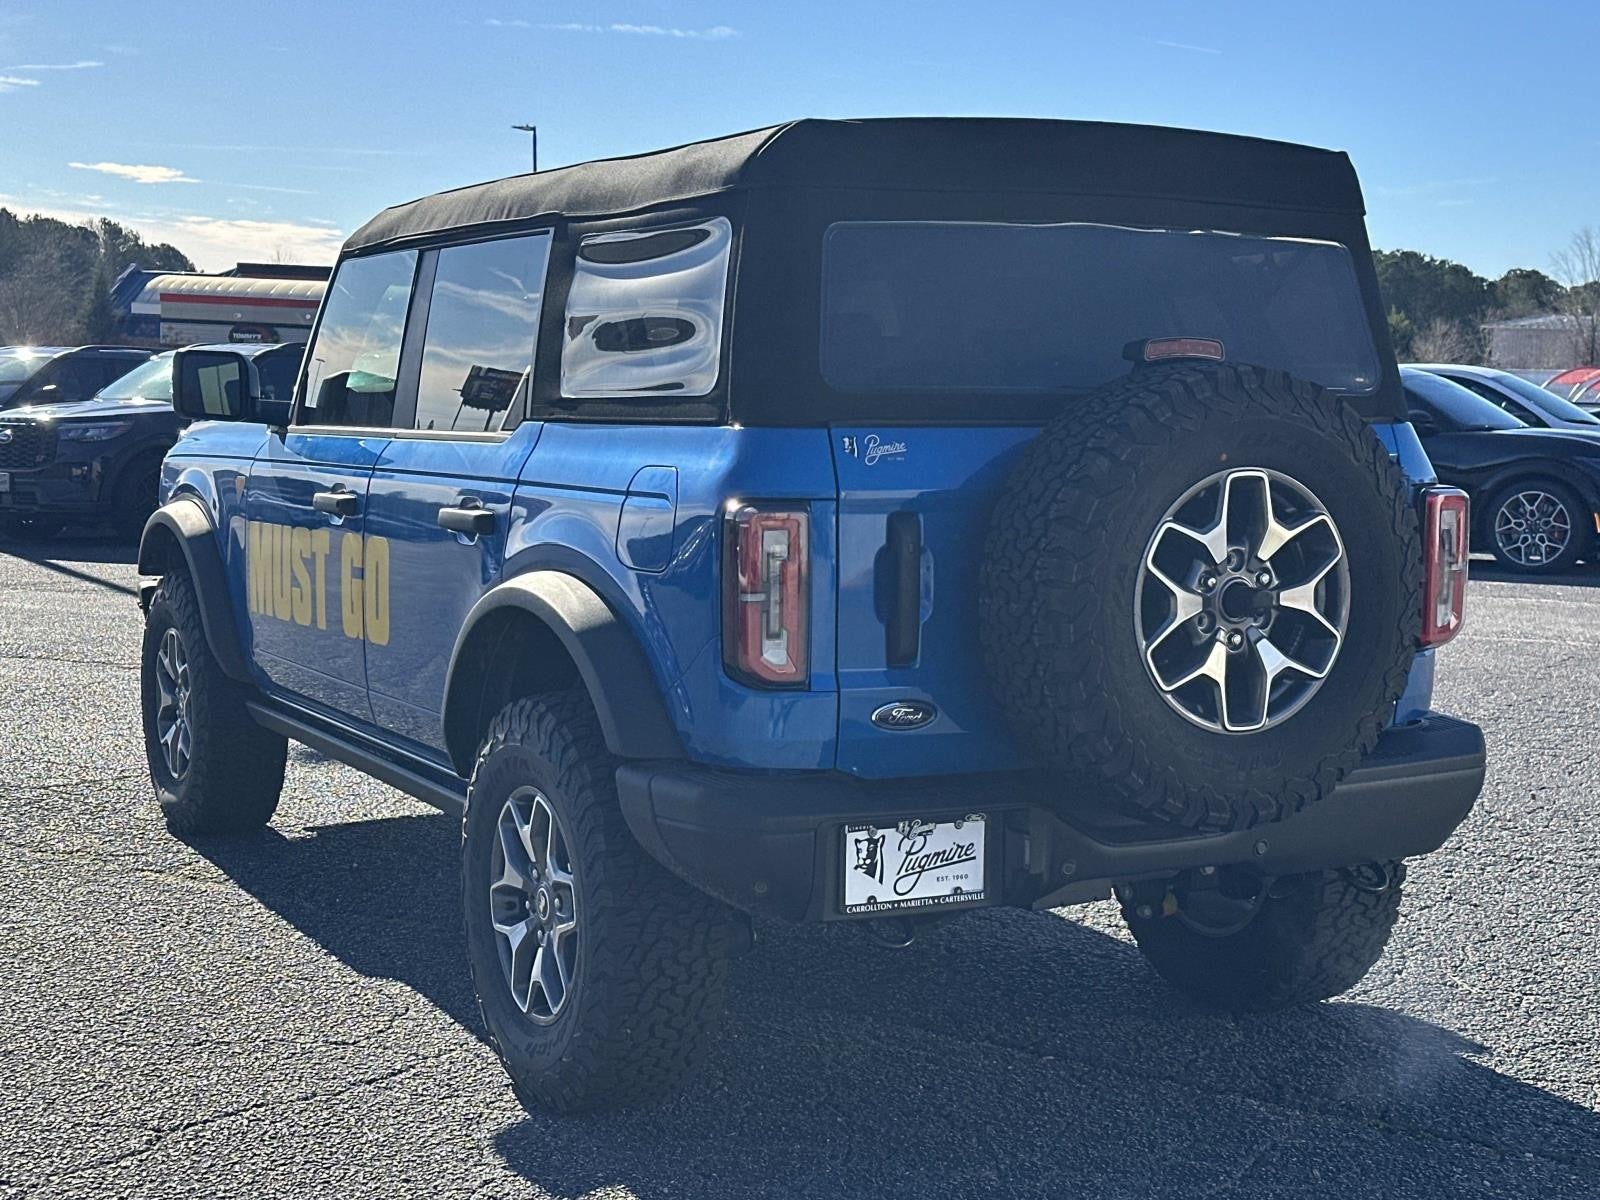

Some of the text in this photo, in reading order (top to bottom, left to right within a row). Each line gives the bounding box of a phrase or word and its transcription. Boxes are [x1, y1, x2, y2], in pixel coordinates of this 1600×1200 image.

[865, 434, 907, 466] Pugmire
[248, 520, 389, 646] MUST GO
[889, 708, 923, 722] Ford
[893, 833, 977, 896] Pugmire
[846, 892, 985, 914] CARROLLTON MARIETTA CARTERSVILLE
